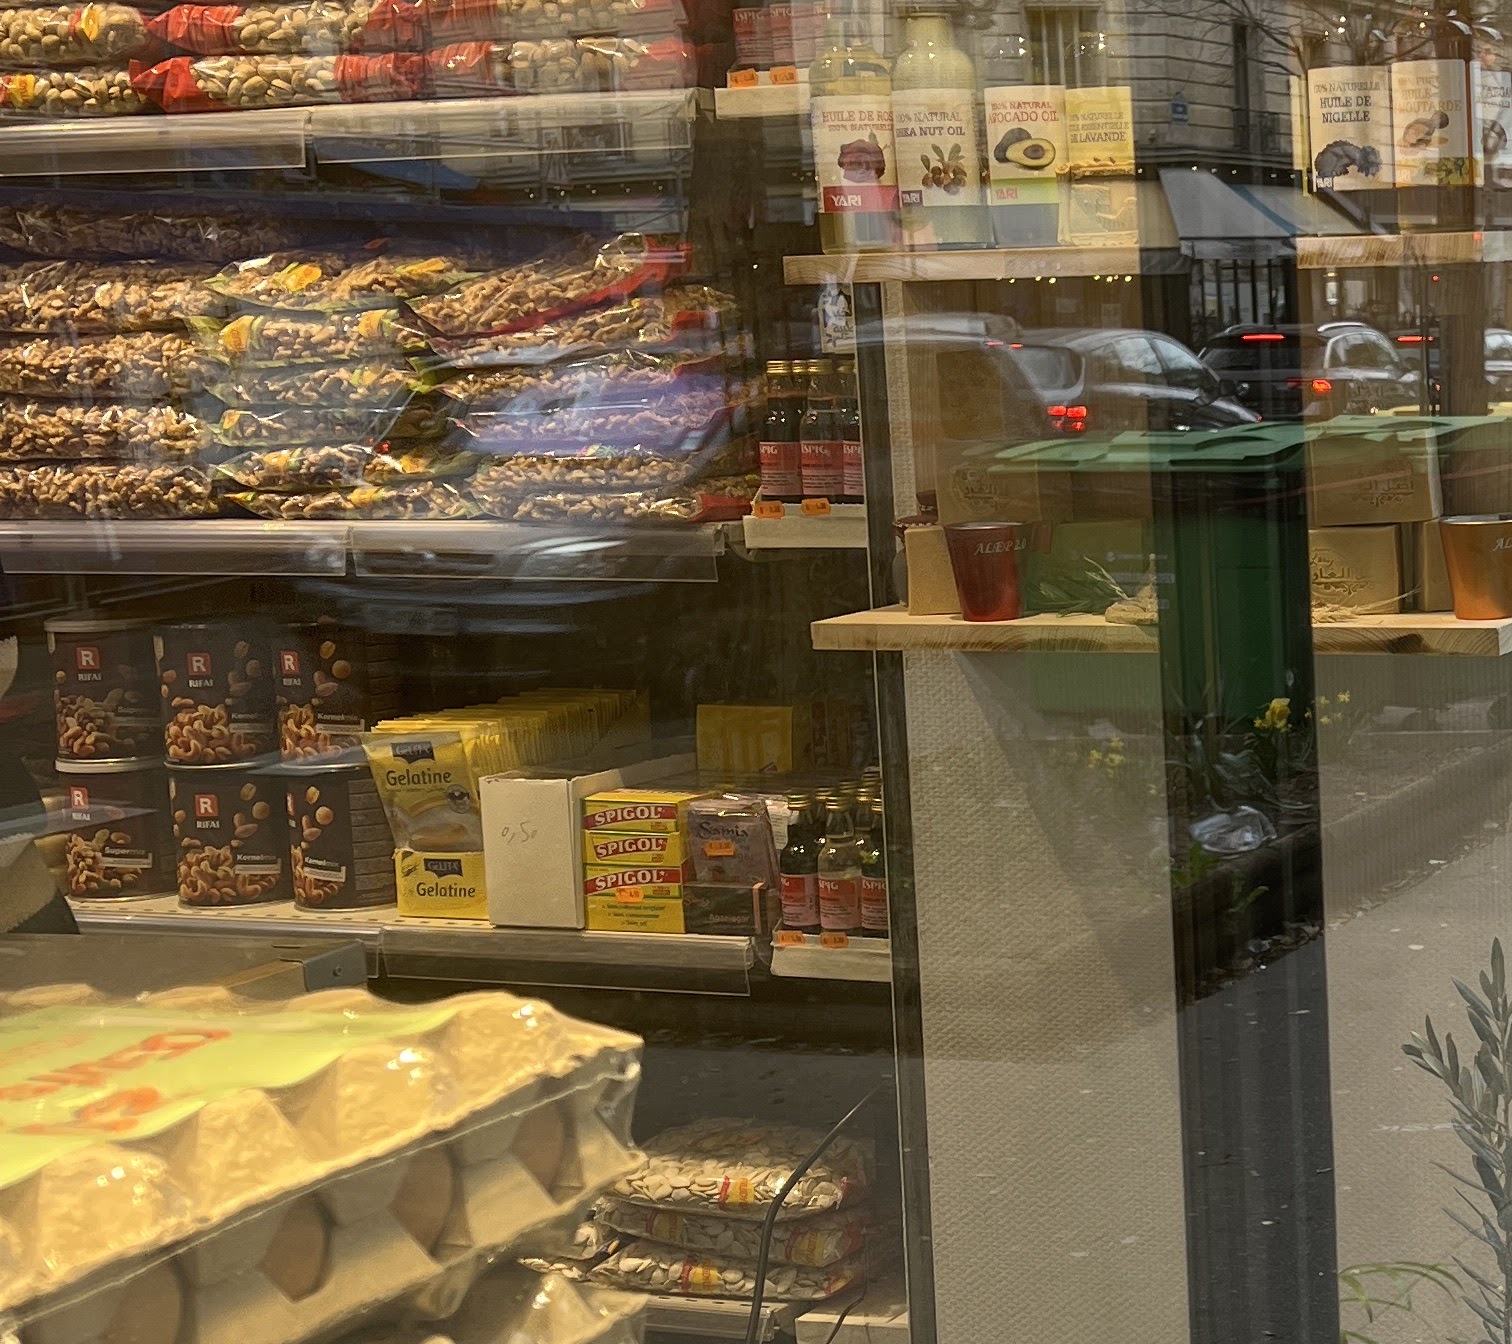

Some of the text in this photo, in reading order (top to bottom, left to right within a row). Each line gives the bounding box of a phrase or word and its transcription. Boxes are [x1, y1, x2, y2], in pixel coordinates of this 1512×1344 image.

[1329, 82, 1381, 93] NATURELLE
[1009, 101, 1051, 111] NATURAL
[1320, 95, 1372, 109] HUILE DE
[822, 111, 856, 123] HUILE
[859, 110, 876, 122] DE
[914, 111, 962, 123] NATURAL
[988, 110, 1060, 124] AVOCADO OIL
[1322, 111, 1371, 124] NIGELLE
[920, 126, 943, 137] NUT
[947, 126, 965, 137] OIL
[1079, 132, 1126, 143] LAVANDE
[831, 195, 861, 207] YARI
[82, 650, 94, 667] R
[192, 656, 205, 673] R
[284, 654, 296, 670] R
[78, 673, 101, 682] RIFAI
[188, 678, 214, 688] RIFAI
[386, 768, 452, 786] Gelatine
[73, 790, 86, 806] R
[200, 798, 213, 814] R
[594, 805, 662, 826] SPIGOL
[196, 820, 220, 830] RIFAI
[595, 837, 662, 858] SPIGOL
[594, 869, 662, 891] SPIGOL
[416, 882, 476, 898] Gelatine
